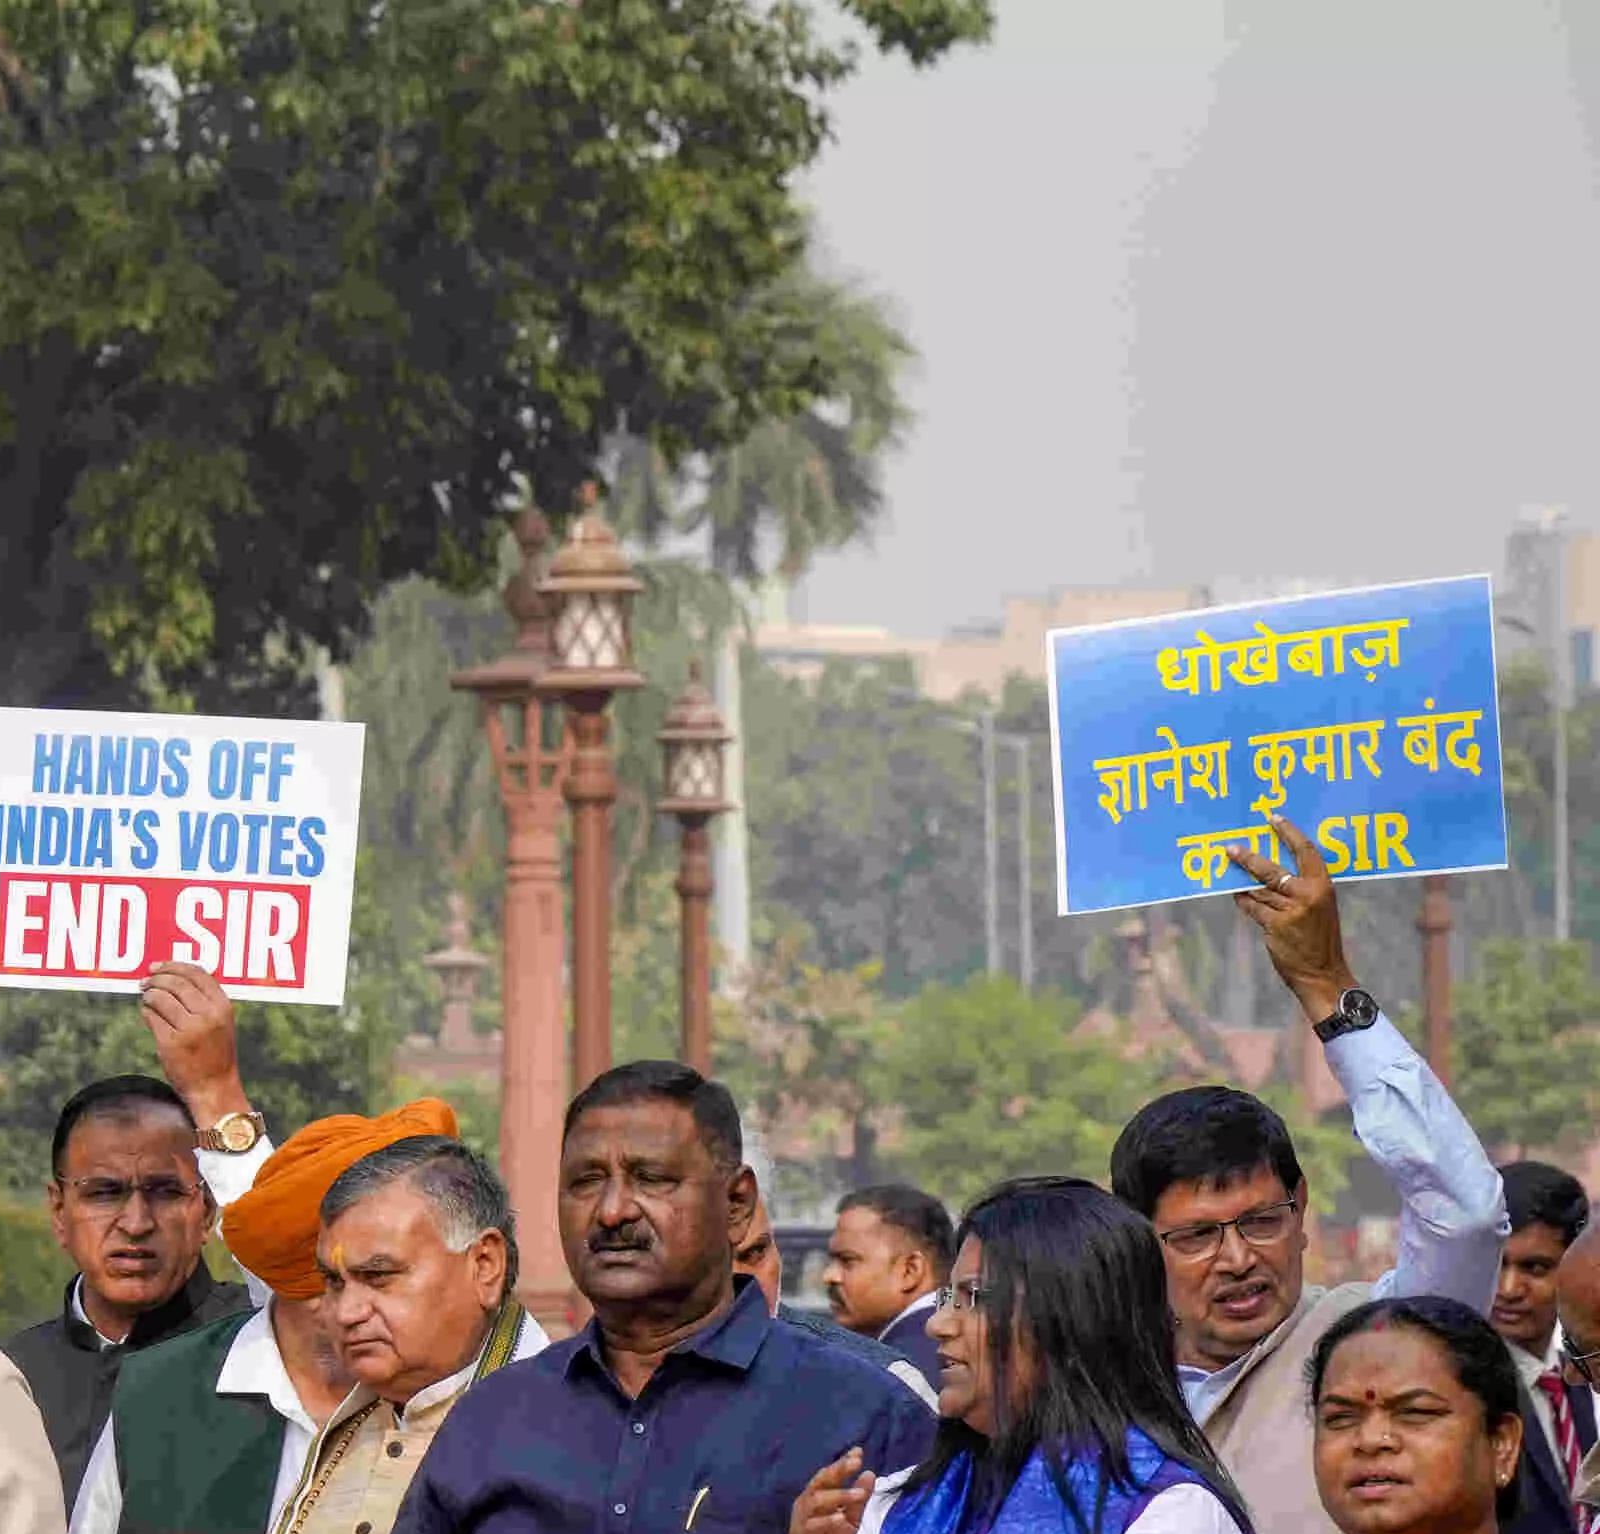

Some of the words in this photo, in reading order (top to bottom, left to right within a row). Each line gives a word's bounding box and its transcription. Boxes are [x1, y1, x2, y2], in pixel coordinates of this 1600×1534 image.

[1156, 619, 1409, 695] धोखेबाज़
[31, 733, 191, 798] HANDS
[208, 740, 296, 802] OFF
[1093, 726, 1231, 824] ज्ञानेश
[1248, 719, 1385, 809] कुमार
[1396, 698, 1482, 777] बंद
[178, 811, 327, 878] VOTES
[1316, 811, 1416, 875] SIR
[3, 879, 148, 973] END
[172, 885, 299, 982] SIR
